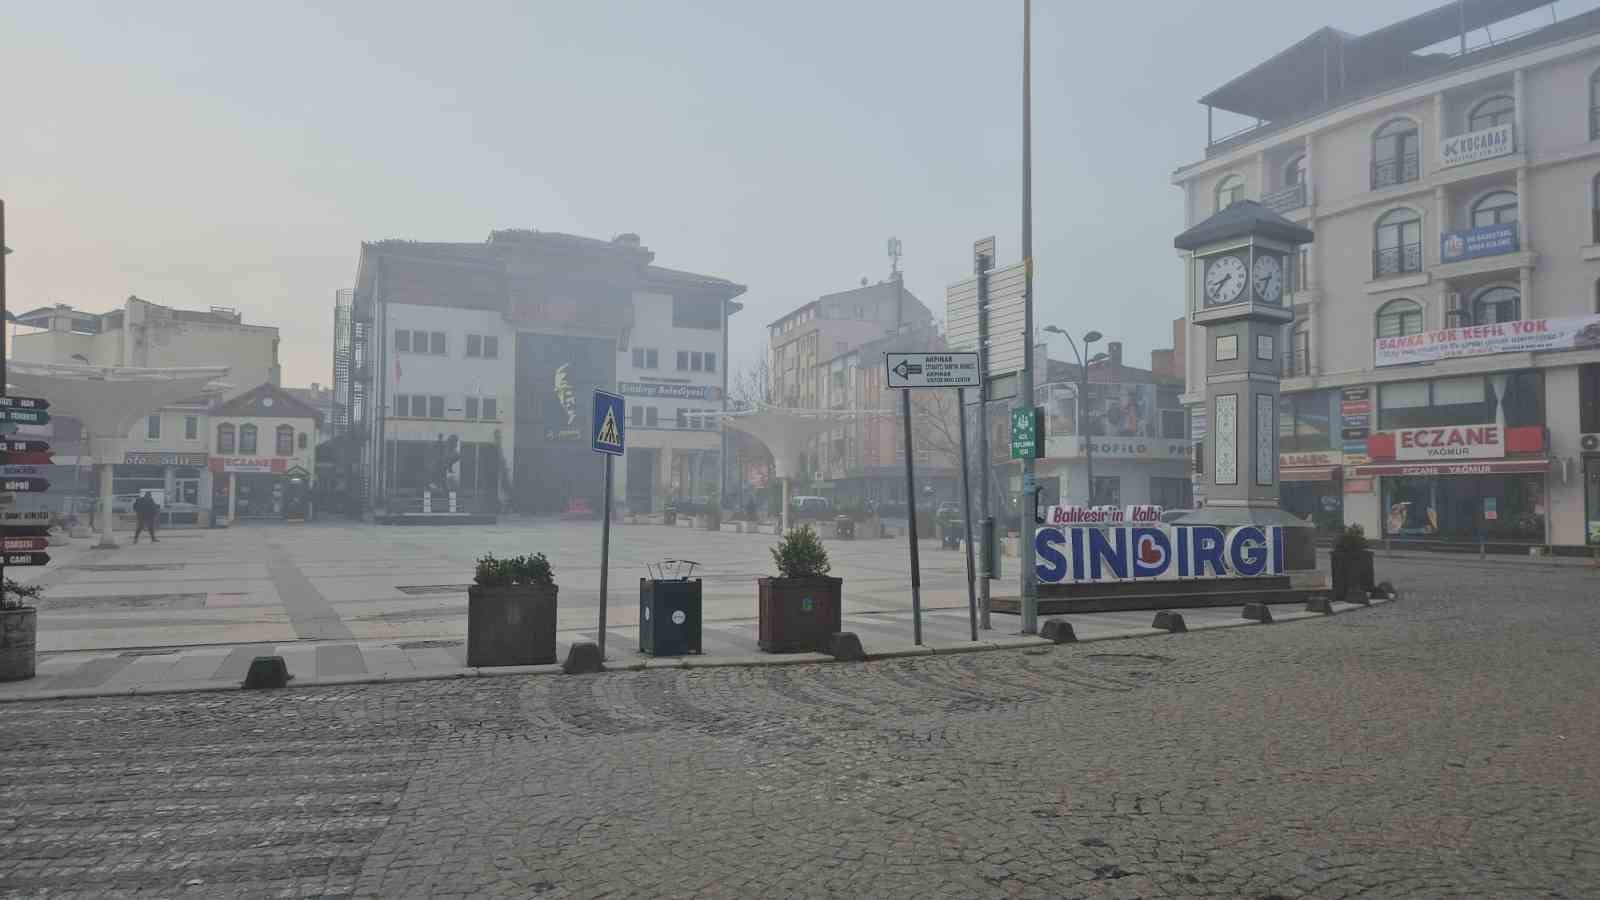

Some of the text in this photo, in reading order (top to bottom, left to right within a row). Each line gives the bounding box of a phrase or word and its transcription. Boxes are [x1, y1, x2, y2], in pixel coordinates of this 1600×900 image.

[1430, 330, 1457, 344] YOK
[1512, 319, 1549, 335] YOK
[1402, 427, 1498, 448] ECZANE
[1132, 505, 1161, 522] Kalbi
[1035, 526, 1282, 584] SINDIRGI
